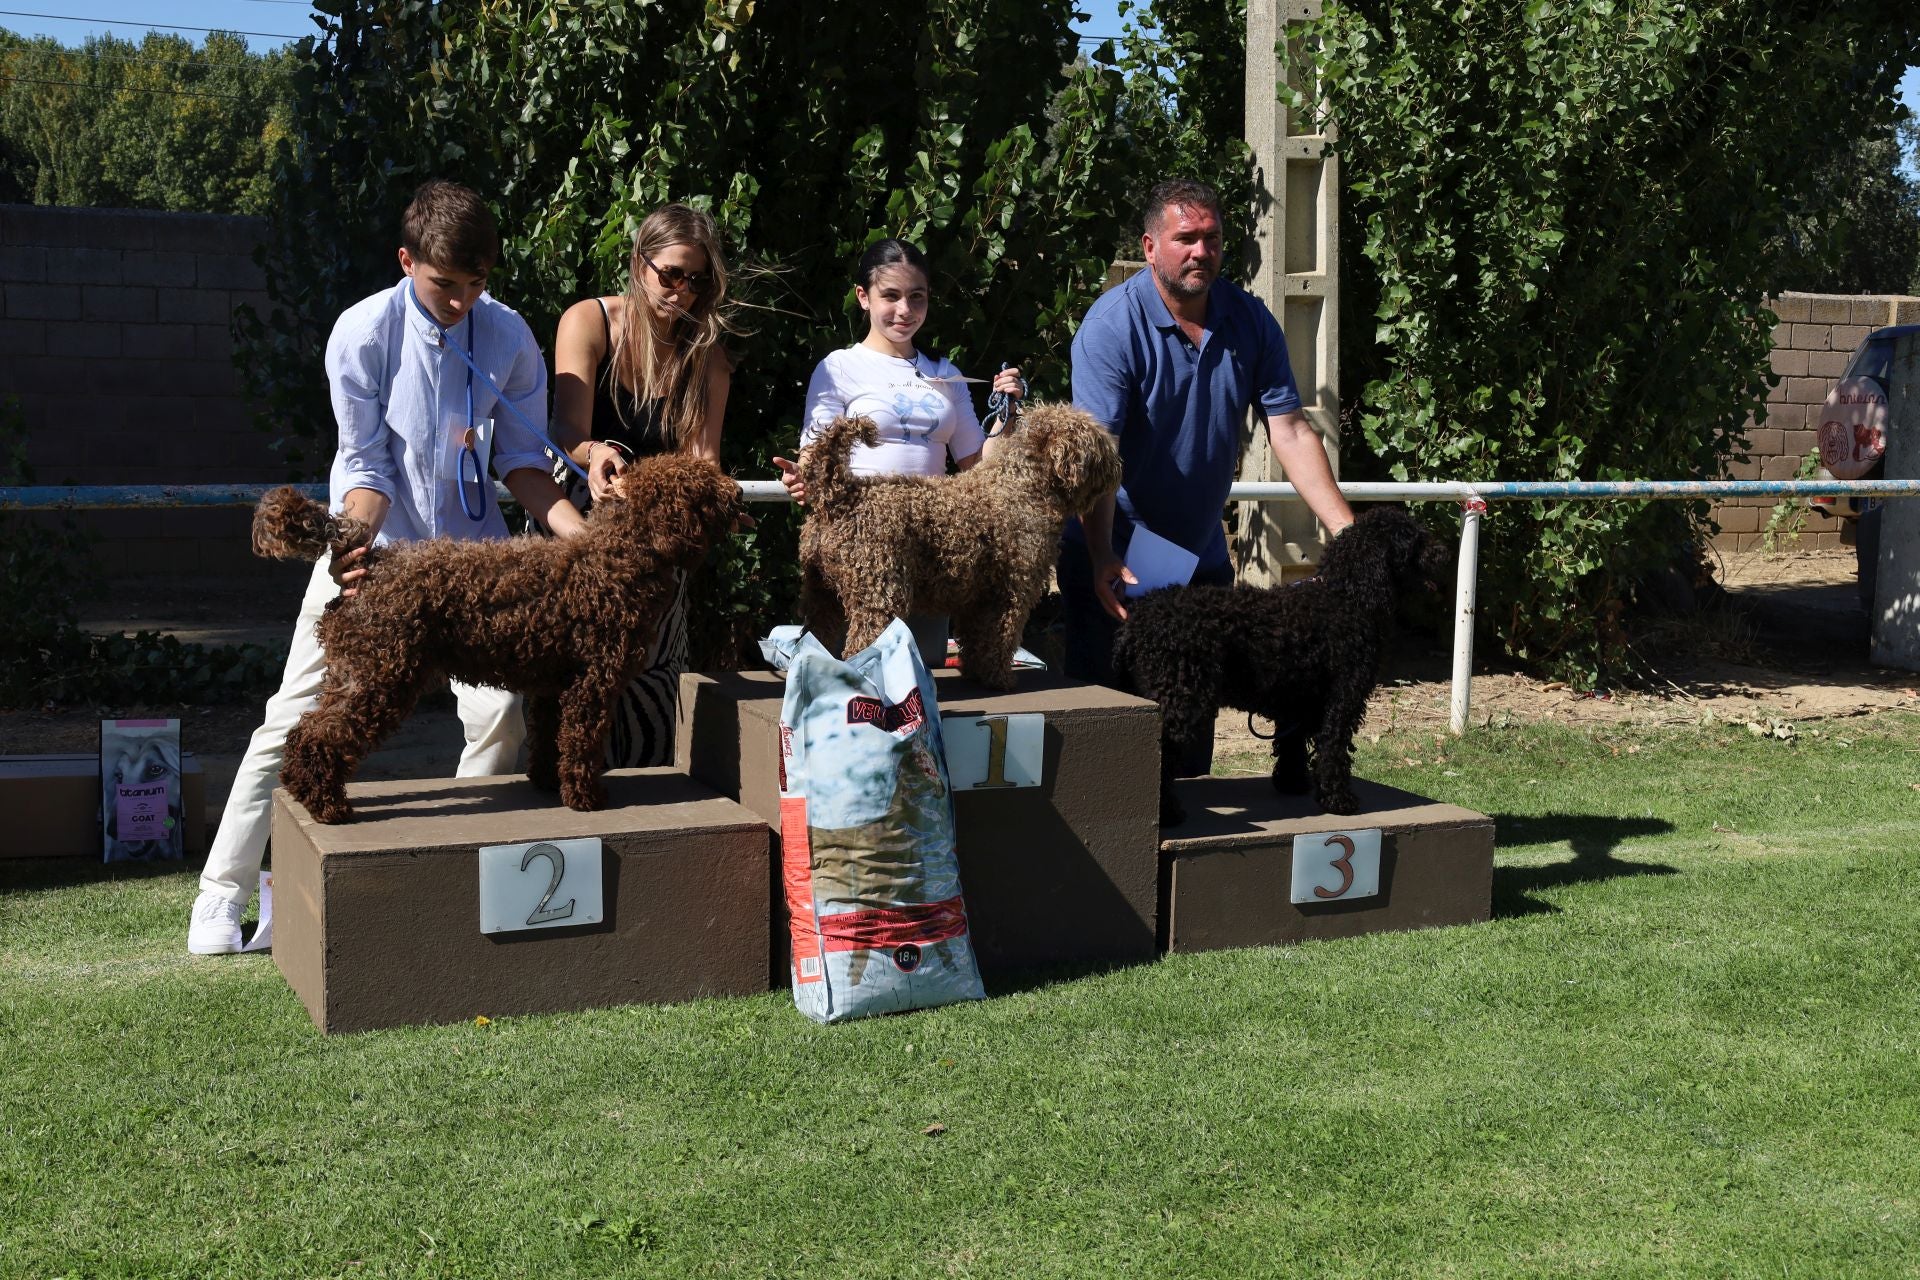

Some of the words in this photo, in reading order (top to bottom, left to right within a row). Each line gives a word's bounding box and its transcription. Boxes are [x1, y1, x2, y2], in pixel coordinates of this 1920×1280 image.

[973, 716, 1018, 788] 1
[120, 787, 164, 797] titanium
[520, 843, 576, 925] 2
[1313, 834, 1355, 899] 3
[899, 951, 910, 963] 18
